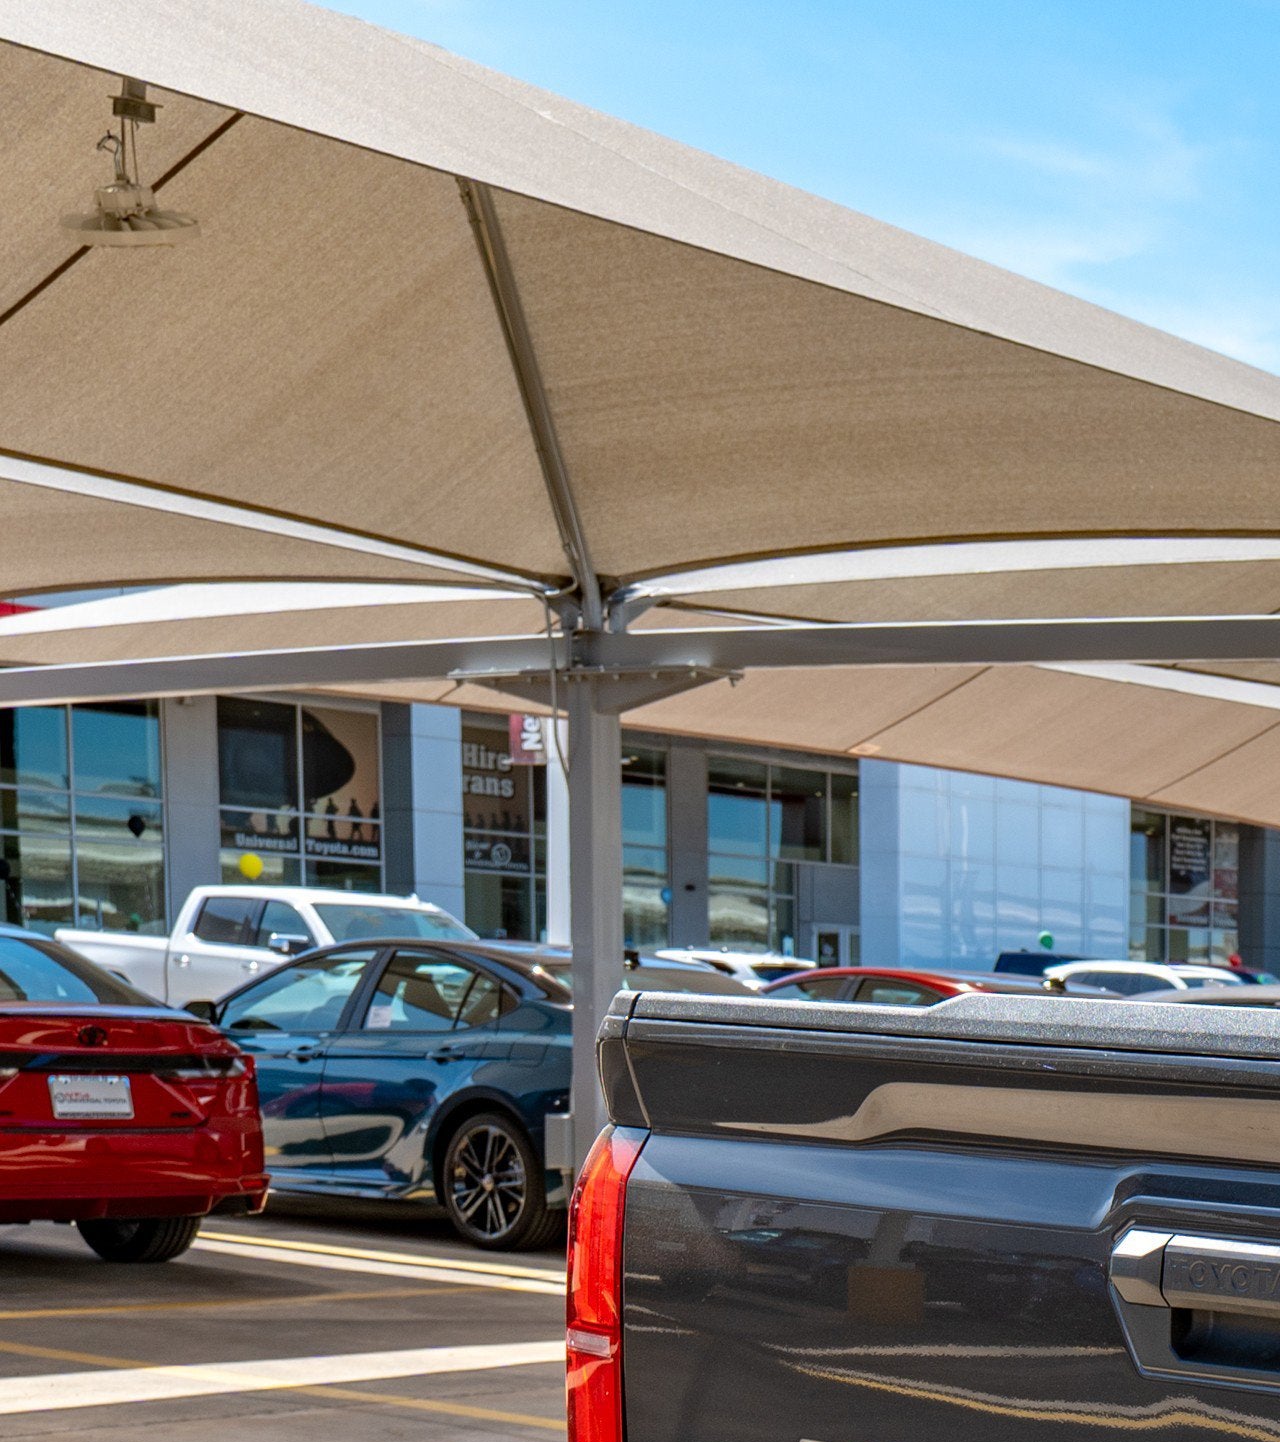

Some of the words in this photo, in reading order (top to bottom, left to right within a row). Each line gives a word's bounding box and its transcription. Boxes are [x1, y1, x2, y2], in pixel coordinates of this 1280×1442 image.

[521, 714, 544, 751] Ne
[463, 743, 513, 772] Hire
[463, 774, 515, 798] rans
[235, 832, 298, 851] Universal
[305, 838, 379, 857] Toyota.com
